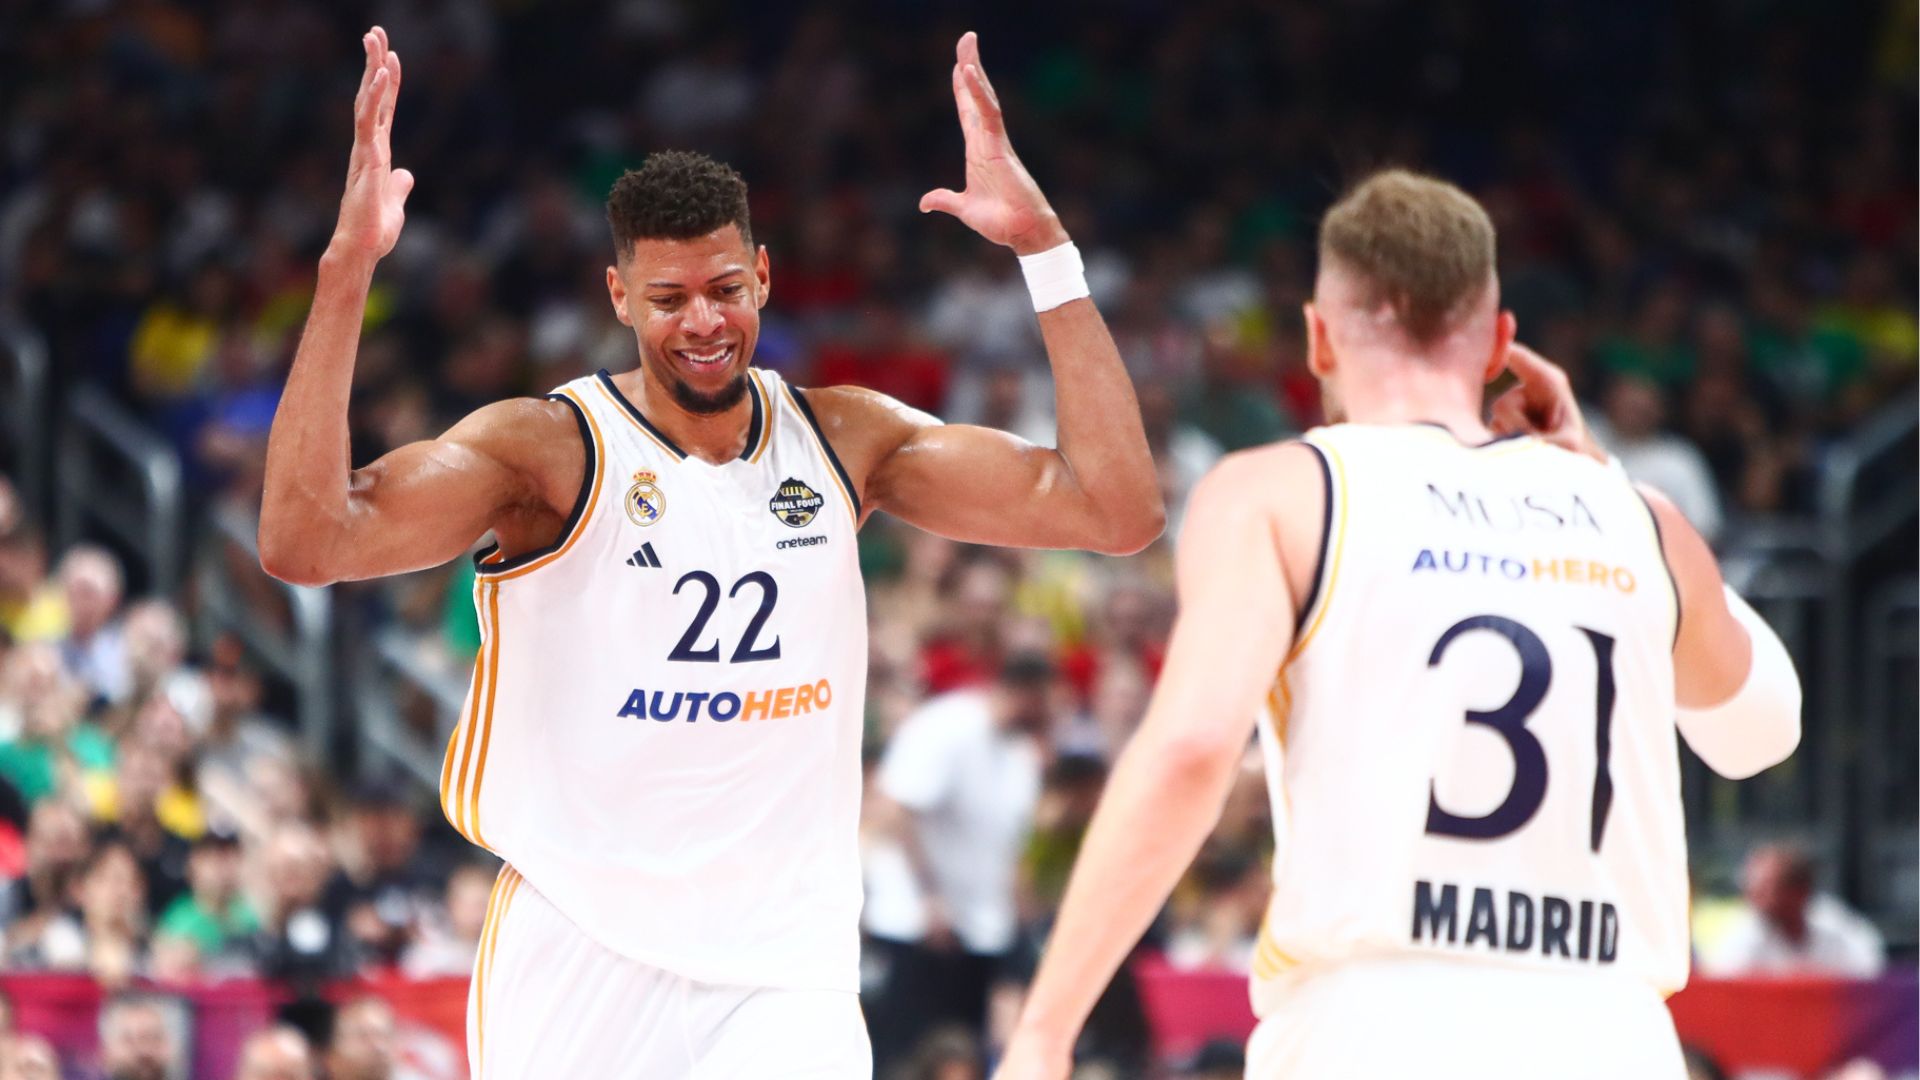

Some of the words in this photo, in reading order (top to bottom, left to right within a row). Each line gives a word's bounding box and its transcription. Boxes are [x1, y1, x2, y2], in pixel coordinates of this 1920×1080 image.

[771, 501, 797, 511] FINAL
[797, 498, 821, 508] FOUR
[1411, 548, 1636, 594] AUTOHERO
[667, 570, 781, 664] 22
[616, 678, 832, 723] AUTOHERO
[1425, 614, 1616, 855] 31
[1412, 880, 1619, 964] MADRID
